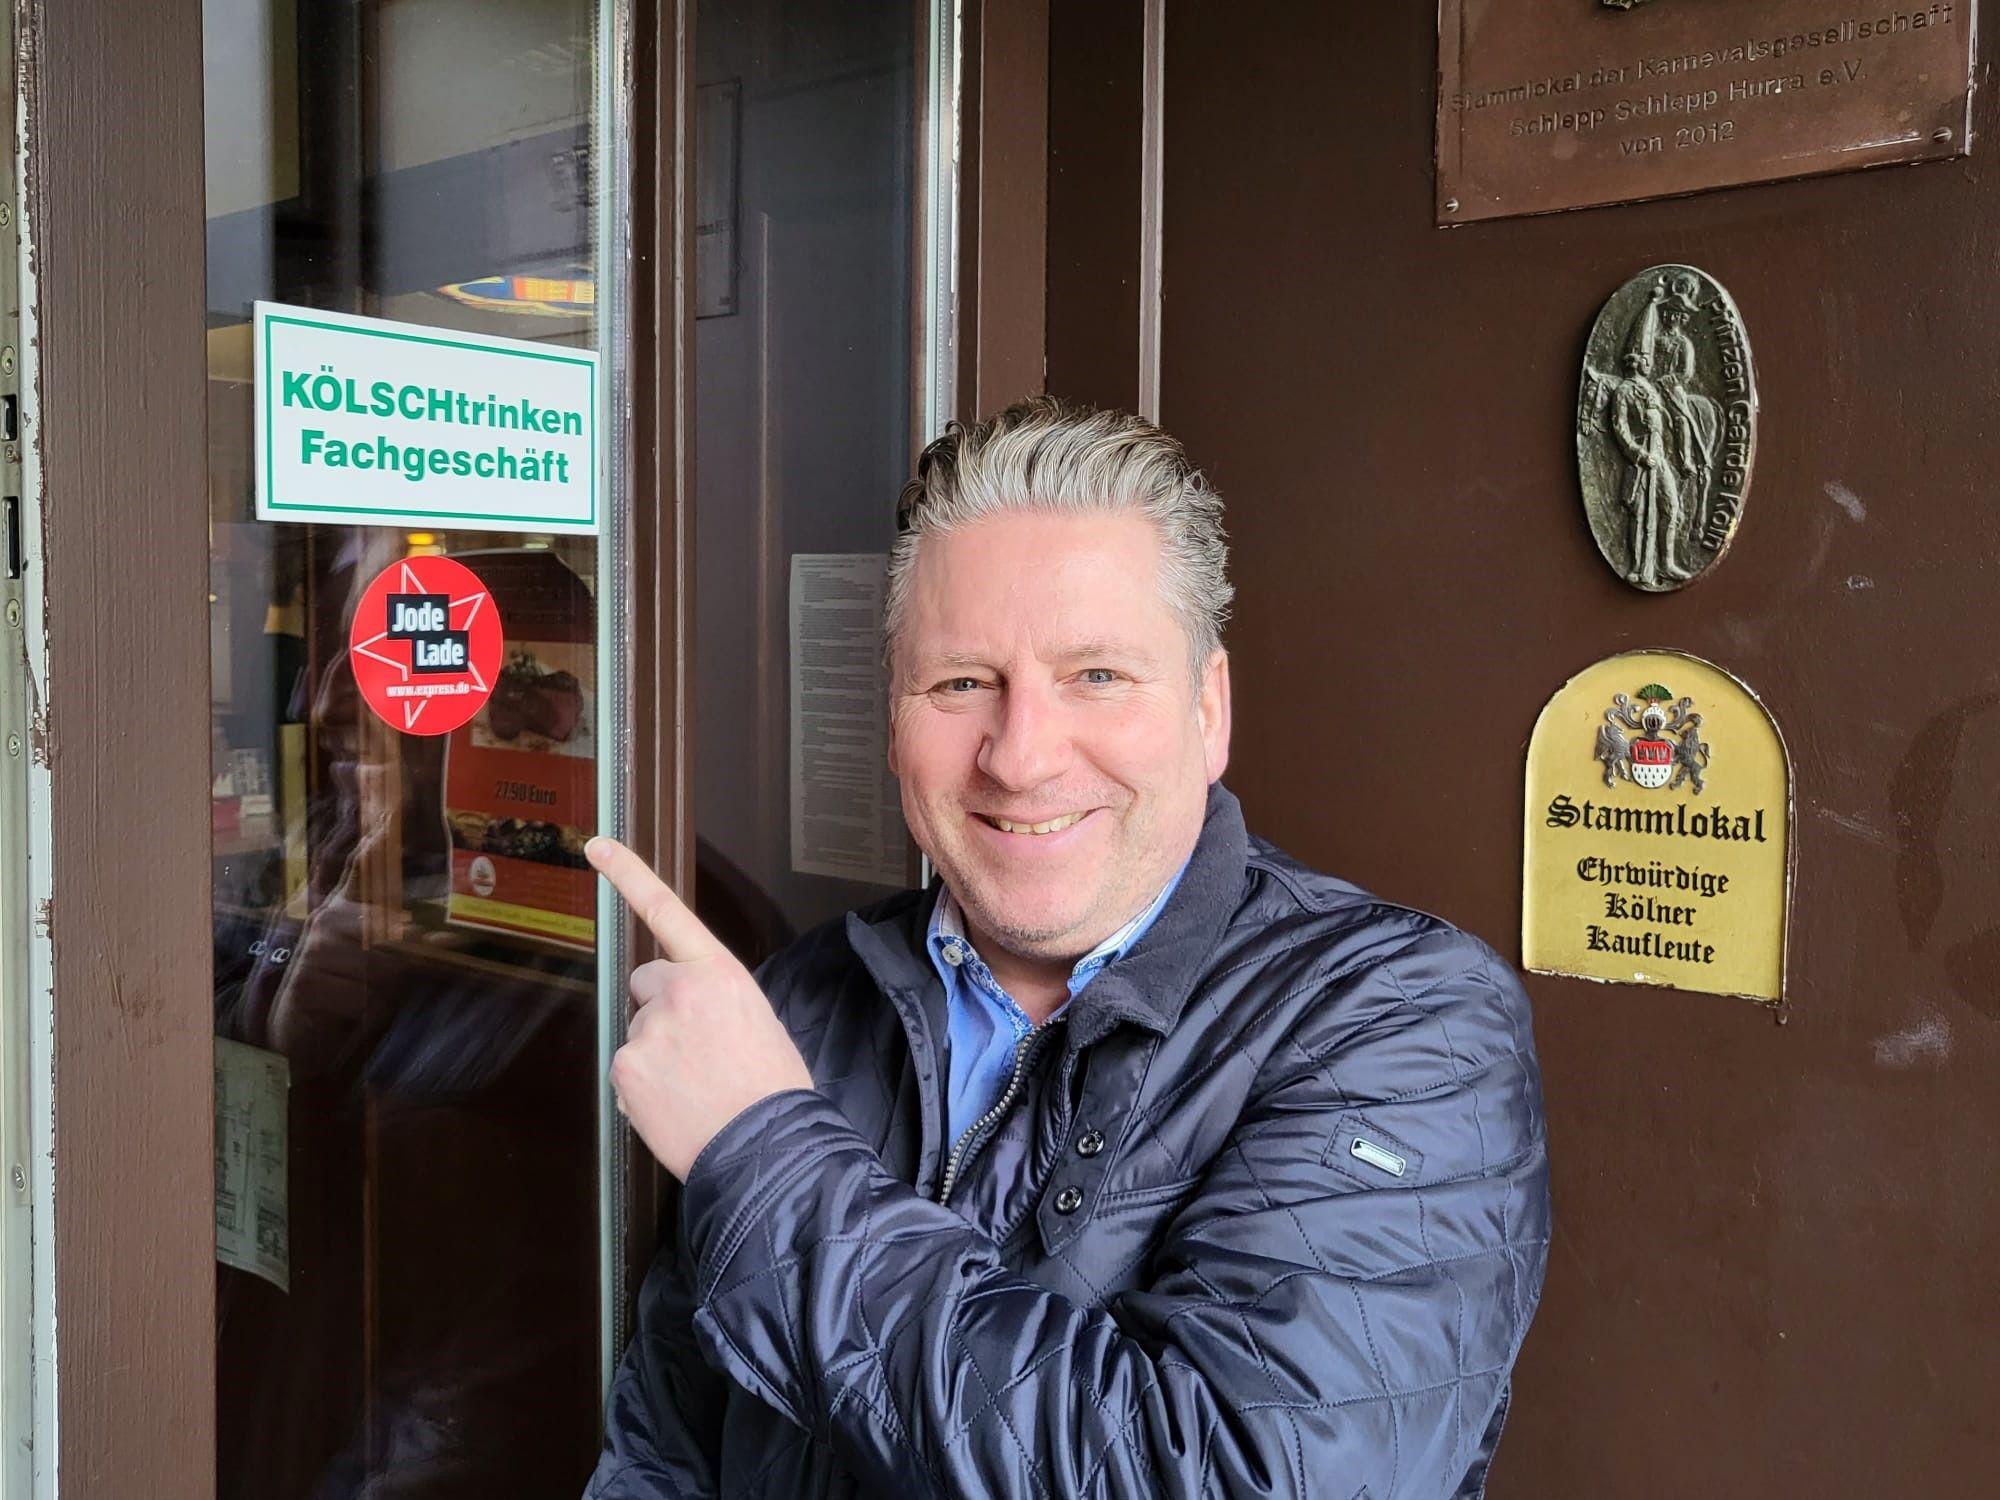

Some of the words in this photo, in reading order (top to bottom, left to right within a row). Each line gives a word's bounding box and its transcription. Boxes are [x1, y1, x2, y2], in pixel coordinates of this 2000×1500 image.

[1450, 71, 1582, 113] Stammlokal
[1589, 66, 1629, 87] der
[1637, 3, 1953, 80] Karnevalsgesellschaft
[1509, 108, 1606, 138] Schlepp
[1614, 89, 1718, 121] Schlepp
[1729, 72, 1804, 102] Hurra
[1818, 58, 1868, 86] e.V.
[1619, 134, 1664, 157] von
[1675, 120, 1736, 151] 2012
[282, 365, 583, 436] KÖLSCHtrinken
[300, 429, 570, 484] Fachgeschäft
[1722, 399, 1752, 488] Garde
[1702, 491, 1741, 550] Köln
[392, 601, 445, 632] Jode
[416, 638, 464, 666] Lade
[386, 681, 470, 698] www.express.de
[529, 783, 558, 806] Euro
[1546, 794, 1767, 842] Stammlokal
[1577, 856, 1730, 897] Ehrwürdige
[1604, 892, 1697, 927] Kölner
[1586, 925, 1716, 965] Kaufleute
